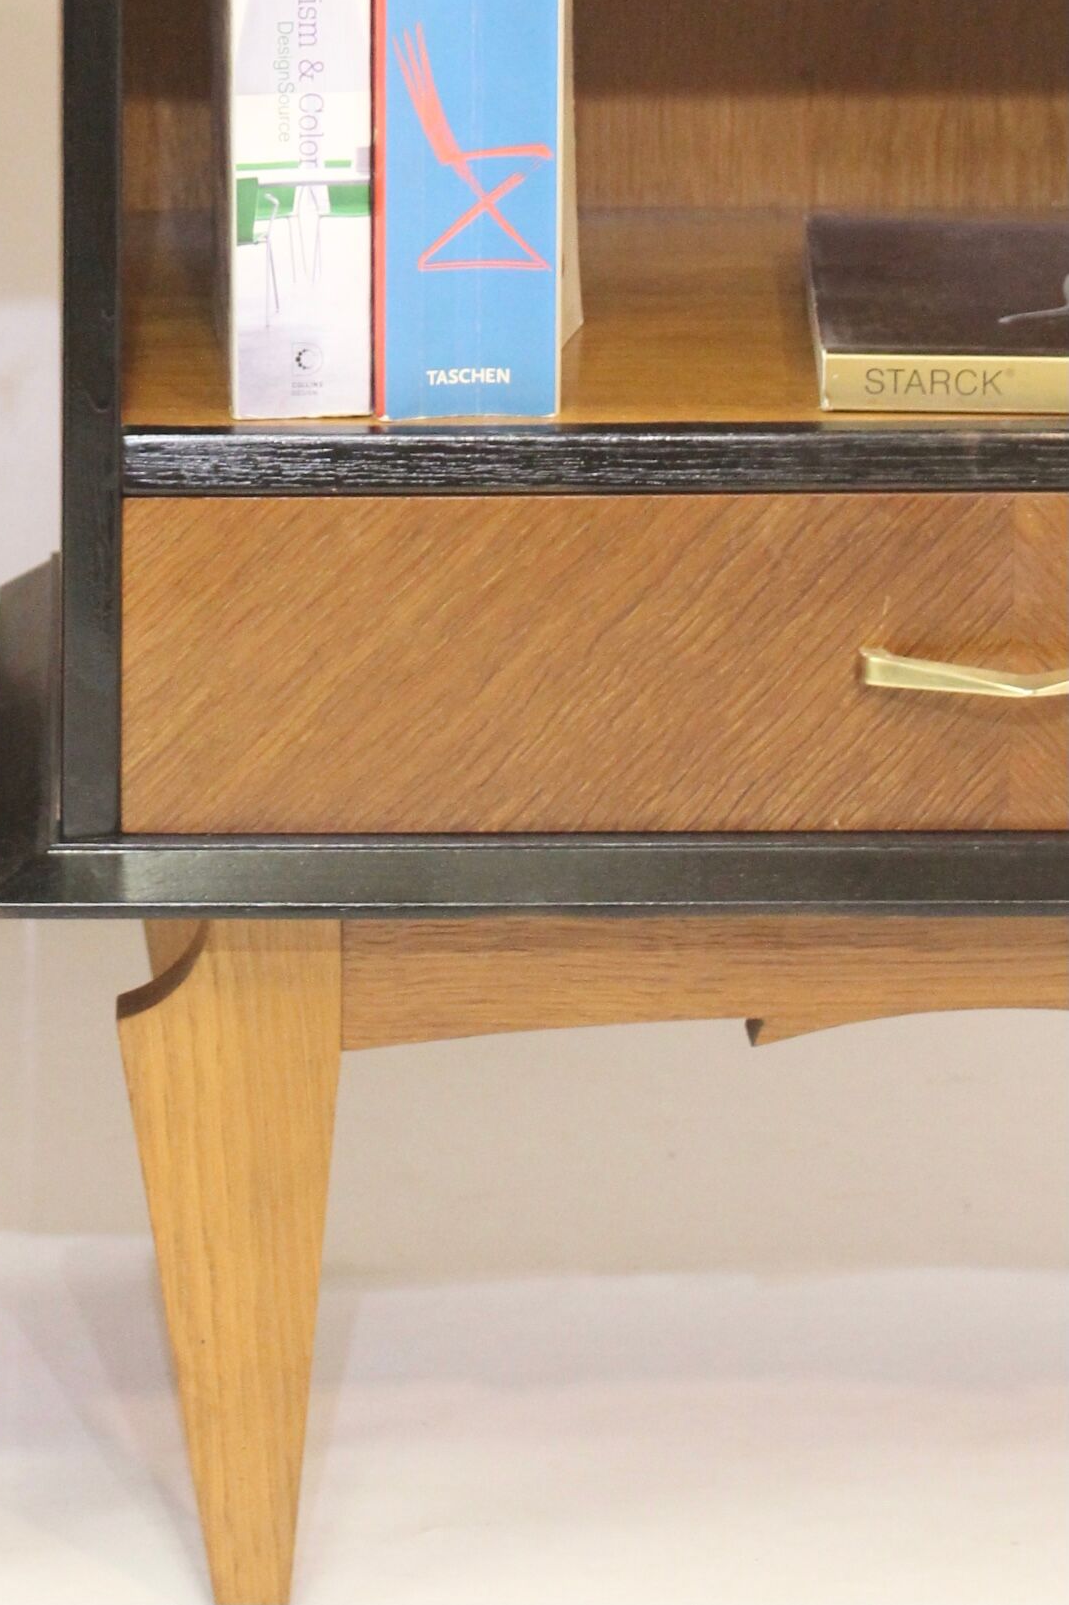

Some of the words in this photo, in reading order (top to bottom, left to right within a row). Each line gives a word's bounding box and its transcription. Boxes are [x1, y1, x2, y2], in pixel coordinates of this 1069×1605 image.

[298, 59, 325, 82] &
[298, 93, 325, 169] Color
[426, 367, 511, 386] TASCHEN
[864, 367, 1003, 396] STARCK
